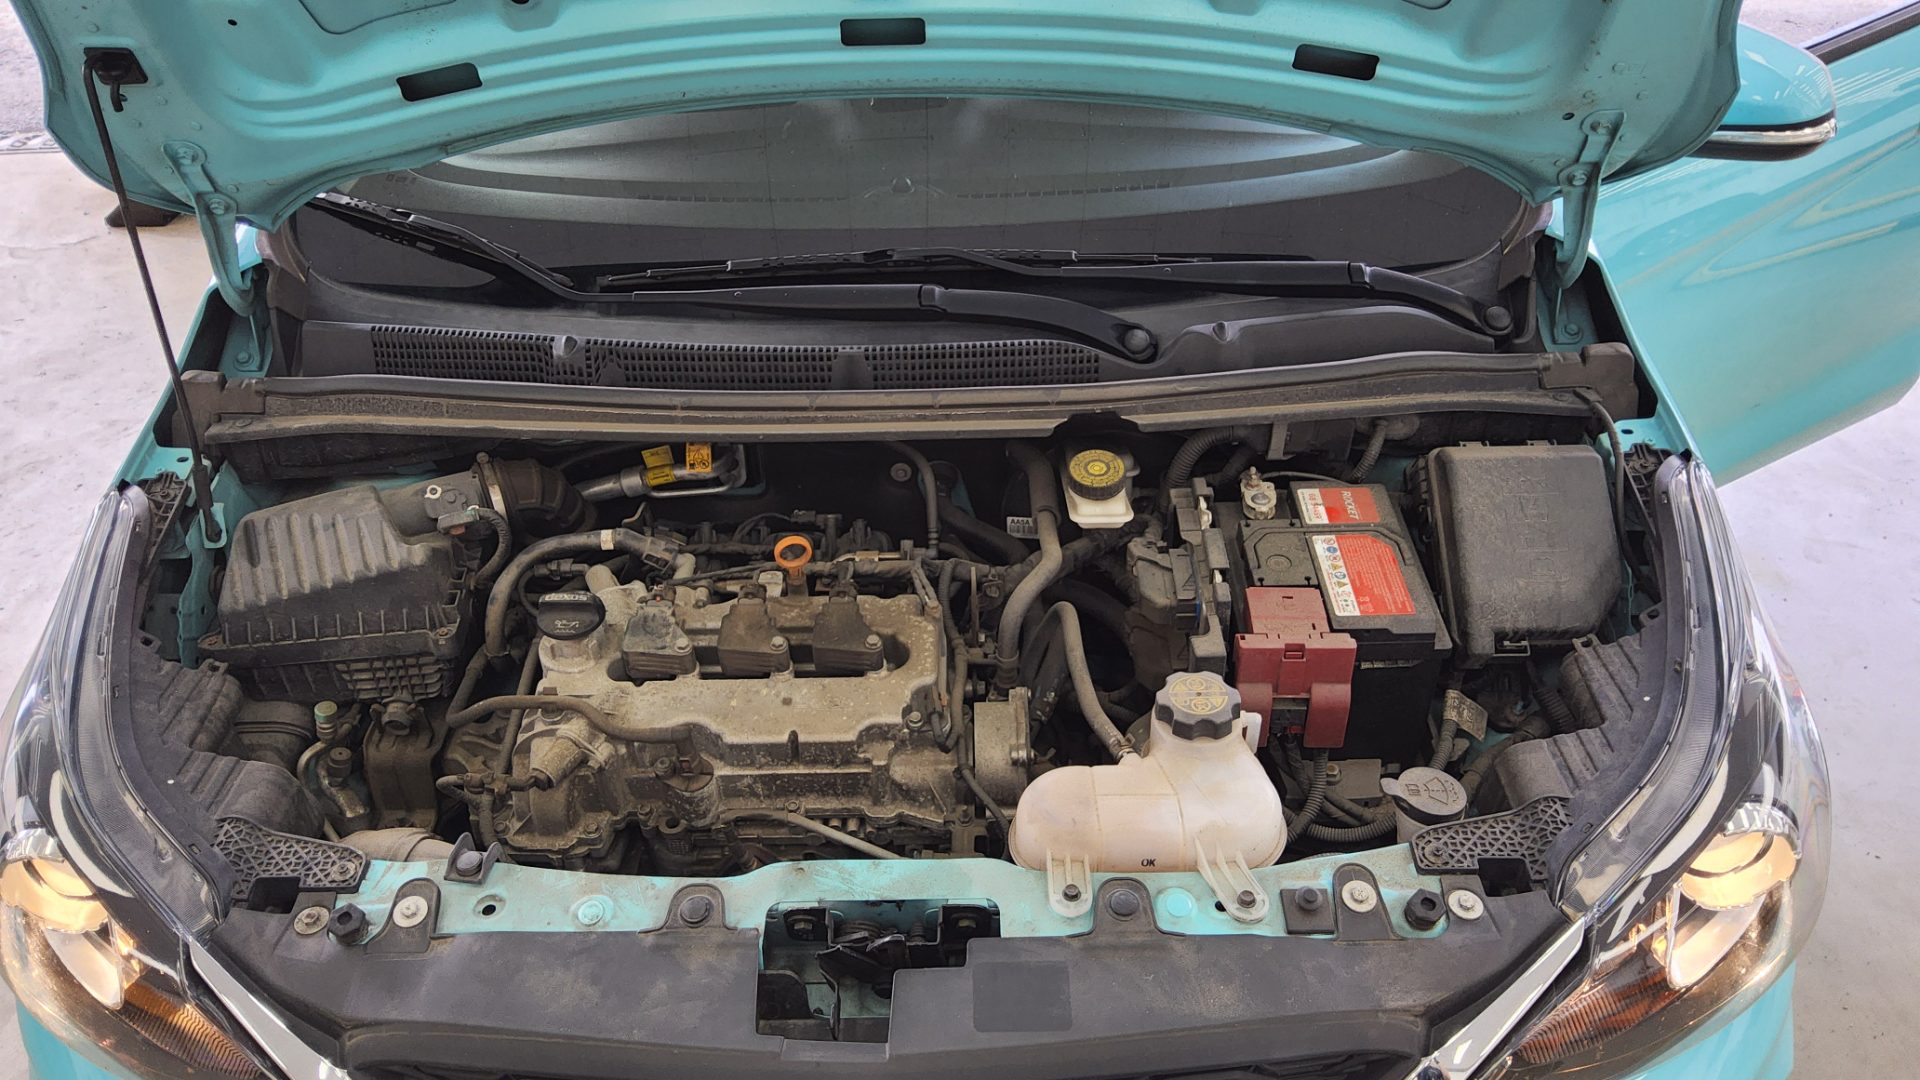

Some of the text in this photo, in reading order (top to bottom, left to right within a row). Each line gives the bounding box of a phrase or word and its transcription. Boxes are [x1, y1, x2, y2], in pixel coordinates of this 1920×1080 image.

[1340, 490, 1360, 520] ROCKET
[544, 592, 588, 601] dexos
[1141, 858, 1156, 868] OK
